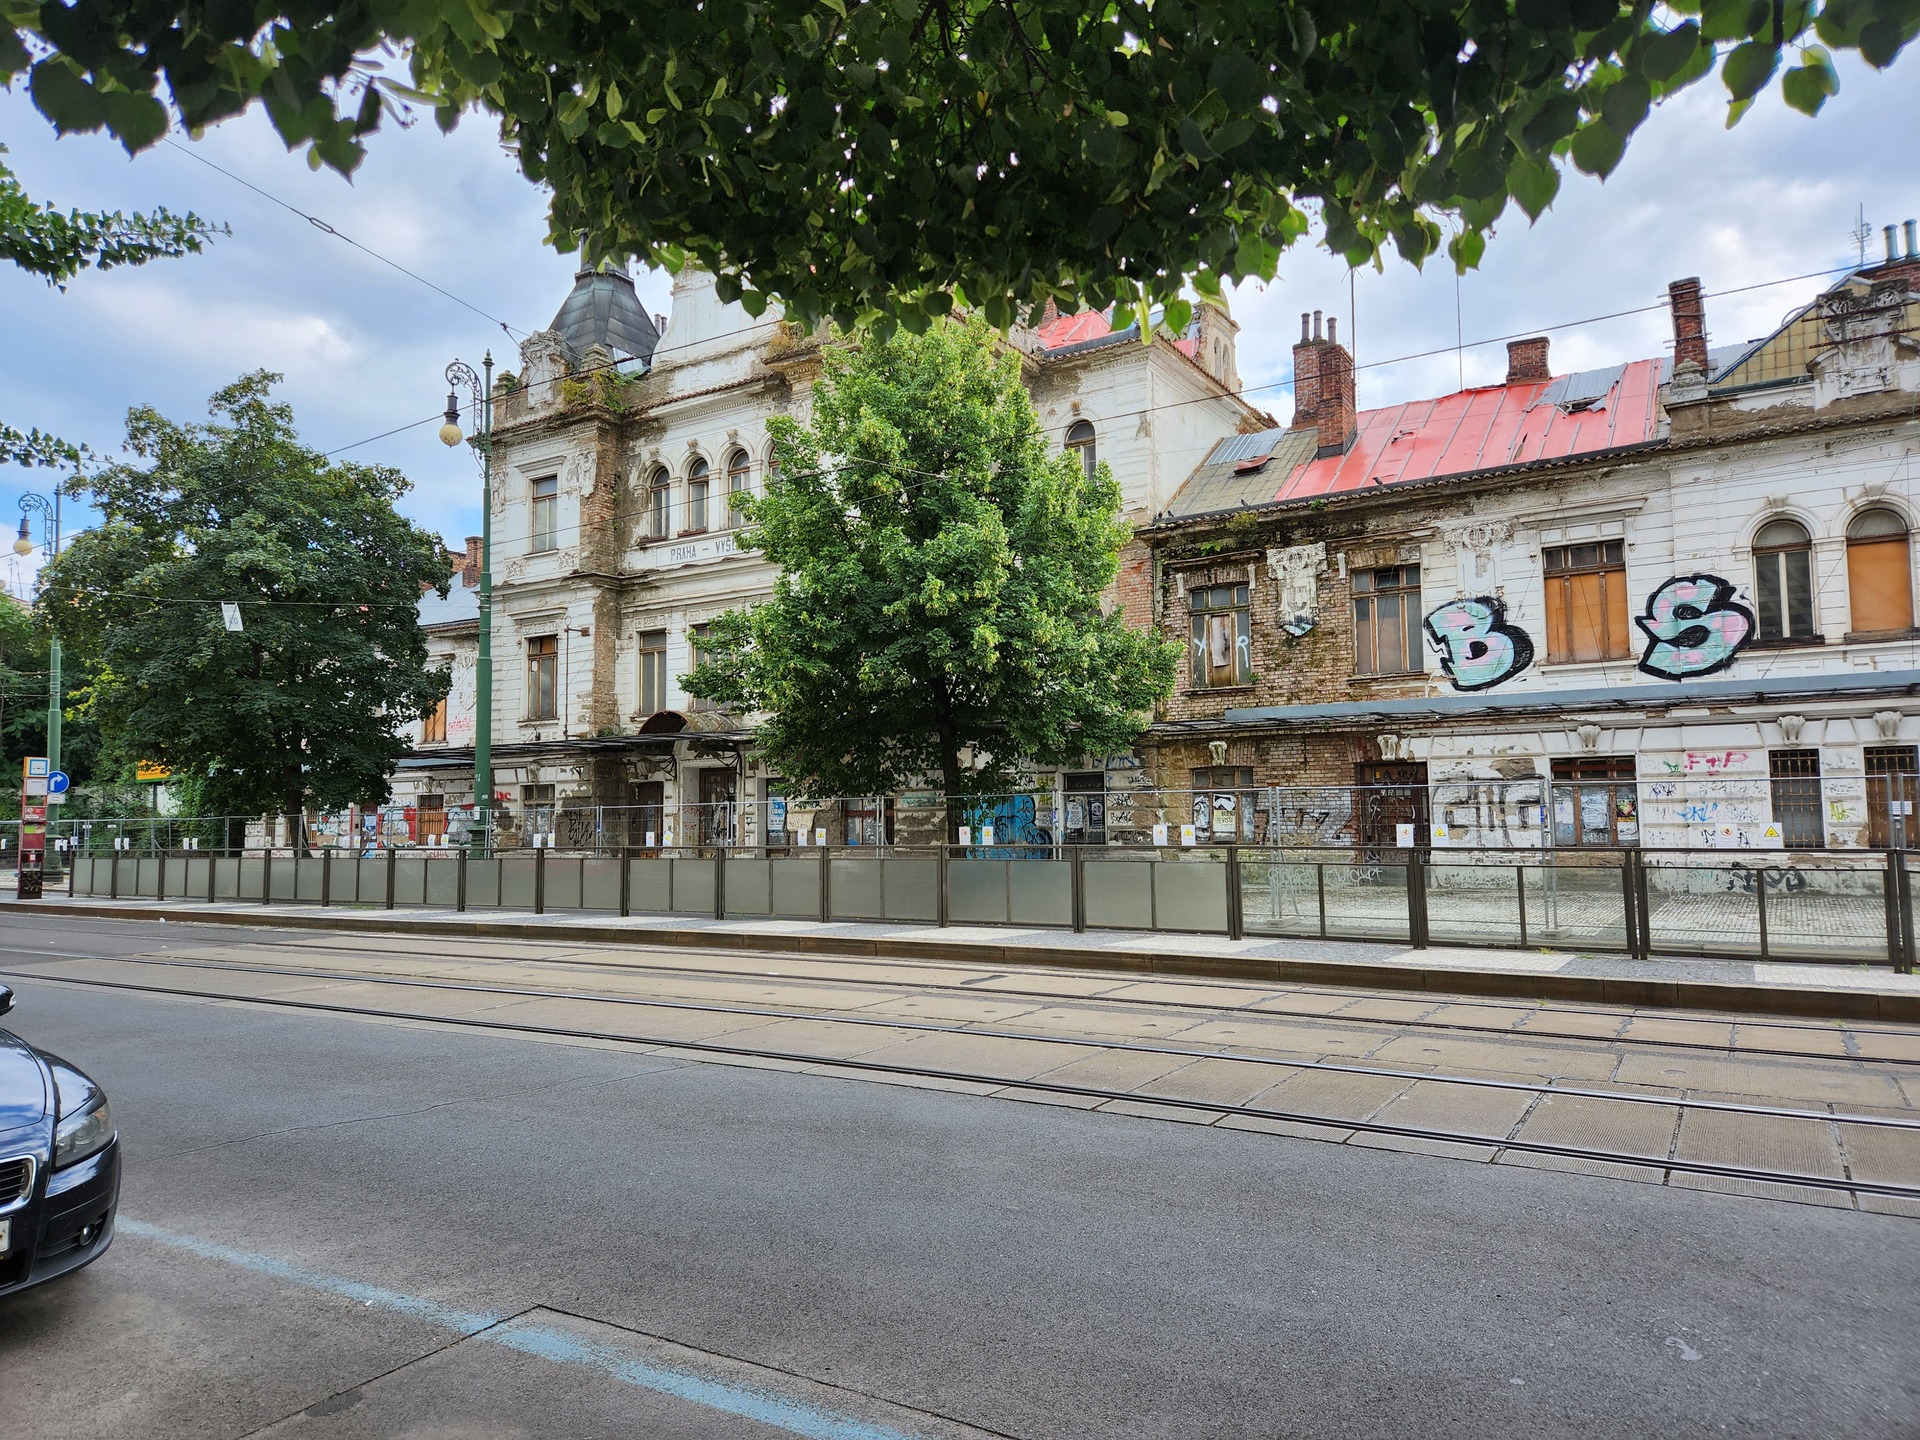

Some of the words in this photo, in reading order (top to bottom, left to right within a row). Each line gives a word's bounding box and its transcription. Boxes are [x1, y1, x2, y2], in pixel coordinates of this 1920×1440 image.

[670, 545, 696, 561] PRAHA
[1423, 596, 1535, 692] B
[1634, 573, 1756, 682] S
